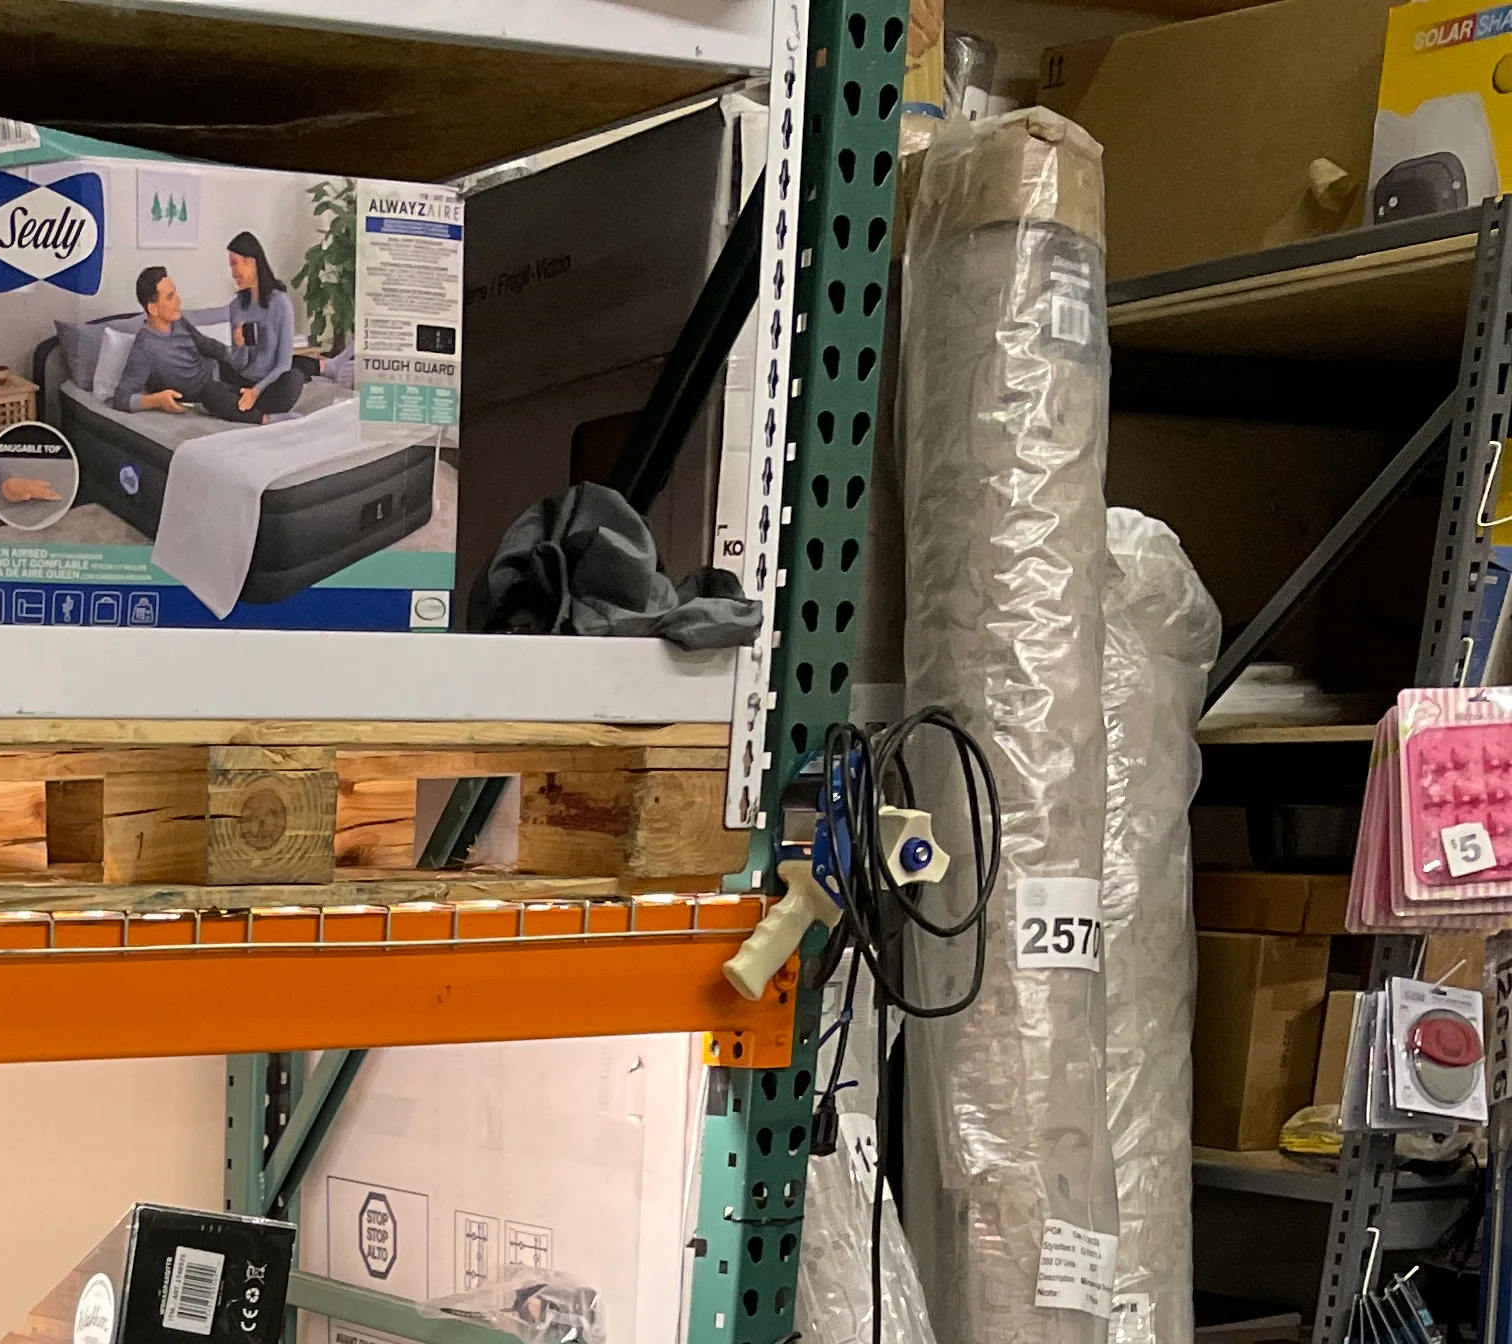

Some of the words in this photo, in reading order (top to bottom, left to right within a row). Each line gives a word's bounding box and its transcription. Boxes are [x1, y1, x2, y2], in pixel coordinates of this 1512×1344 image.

[363, 358, 410, 373] TOUGH
[414, 361, 455, 376] GUARD
[367, 1209, 388, 1226] STOP
[367, 1227, 389, 1244] STOP
[367, 1244, 388, 1262] ALTO
